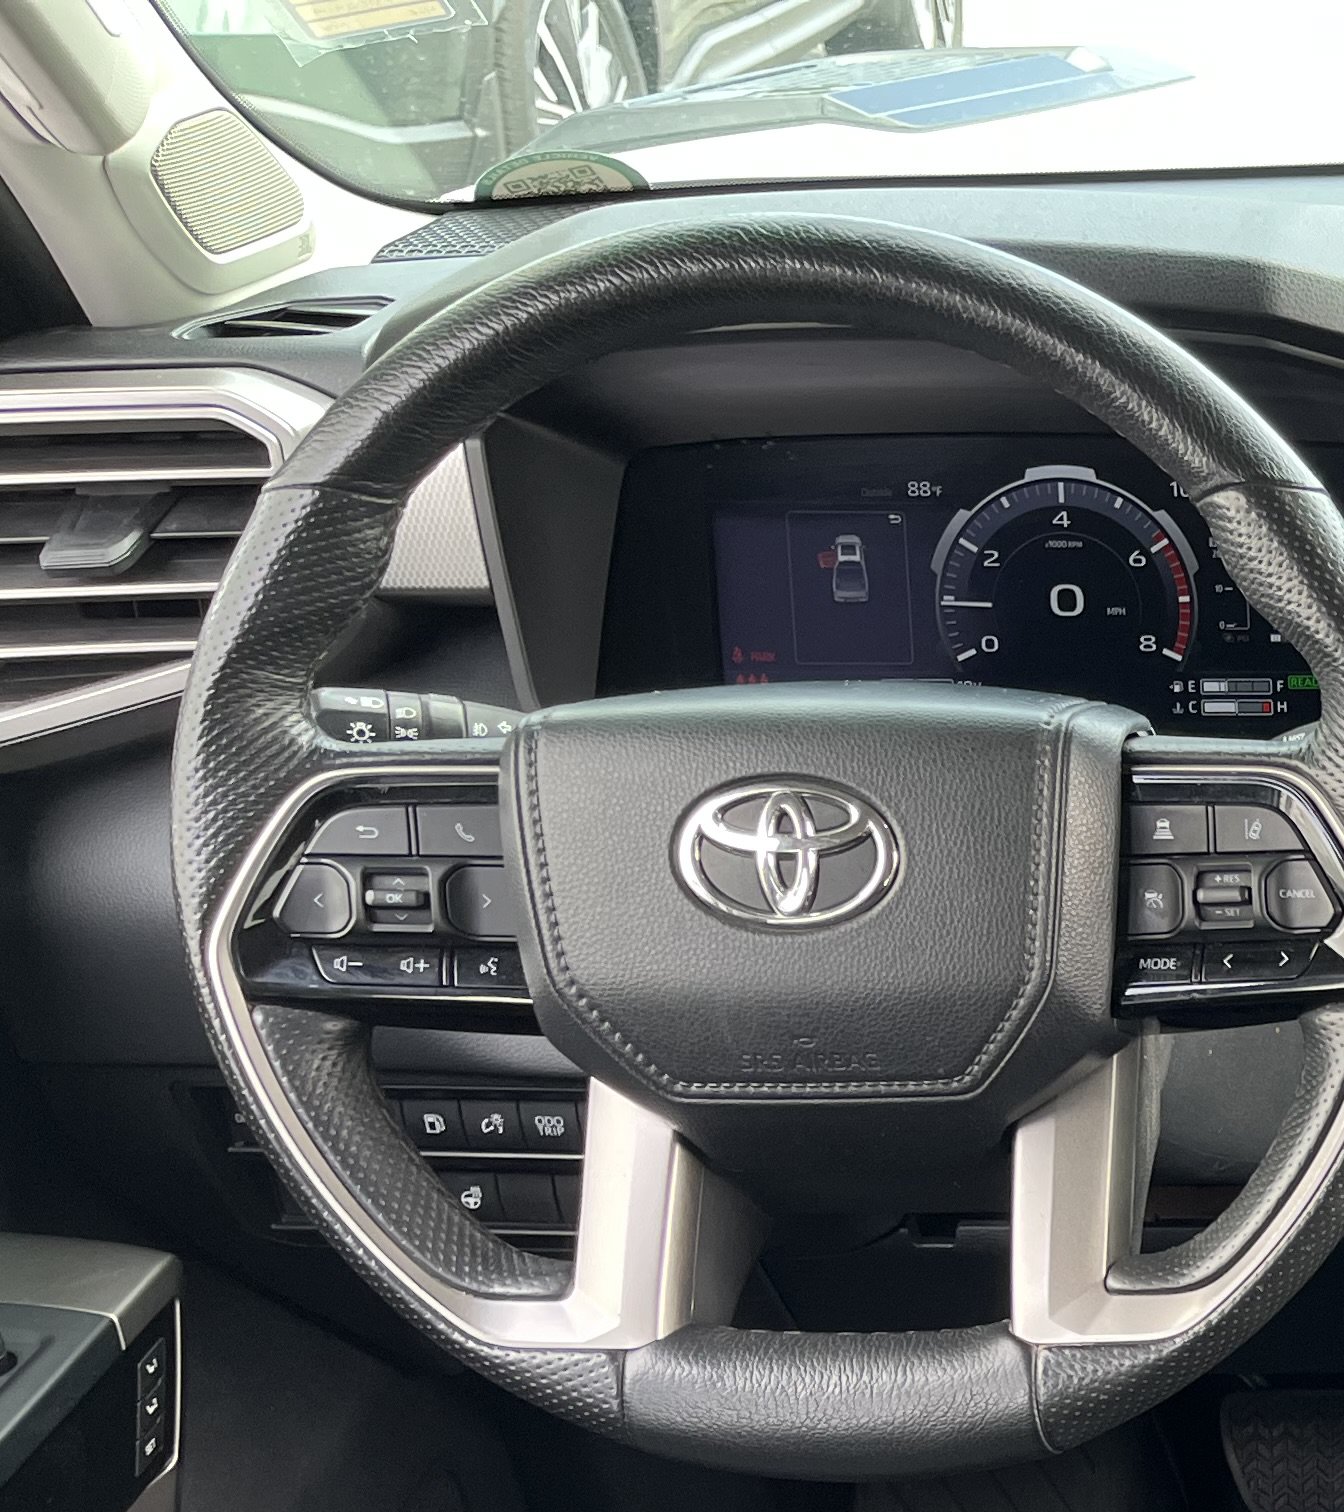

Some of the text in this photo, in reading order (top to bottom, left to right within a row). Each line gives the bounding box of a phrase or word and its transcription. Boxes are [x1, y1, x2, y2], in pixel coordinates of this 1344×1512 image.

[1051, 510, 1071, 528] 4
[982, 550, 1001, 568] 2
[1127, 550, 1147, 568] 6
[1049, 583, 1085, 618] 0
[1106, 607, 1127, 617] MPH
[981, 635, 1000, 653] 0
[1138, 634, 1157, 652] 8
[1187, 680, 1197, 693] E
[1276, 680, 1285, 693] F
[1187, 701, 1198, 715] C
[1277, 701, 1288, 713] H
[1278, 888, 1317, 899] CANCEL
[1138, 957, 1178, 970] MODE
[535, 1115, 564, 1127] ODO
